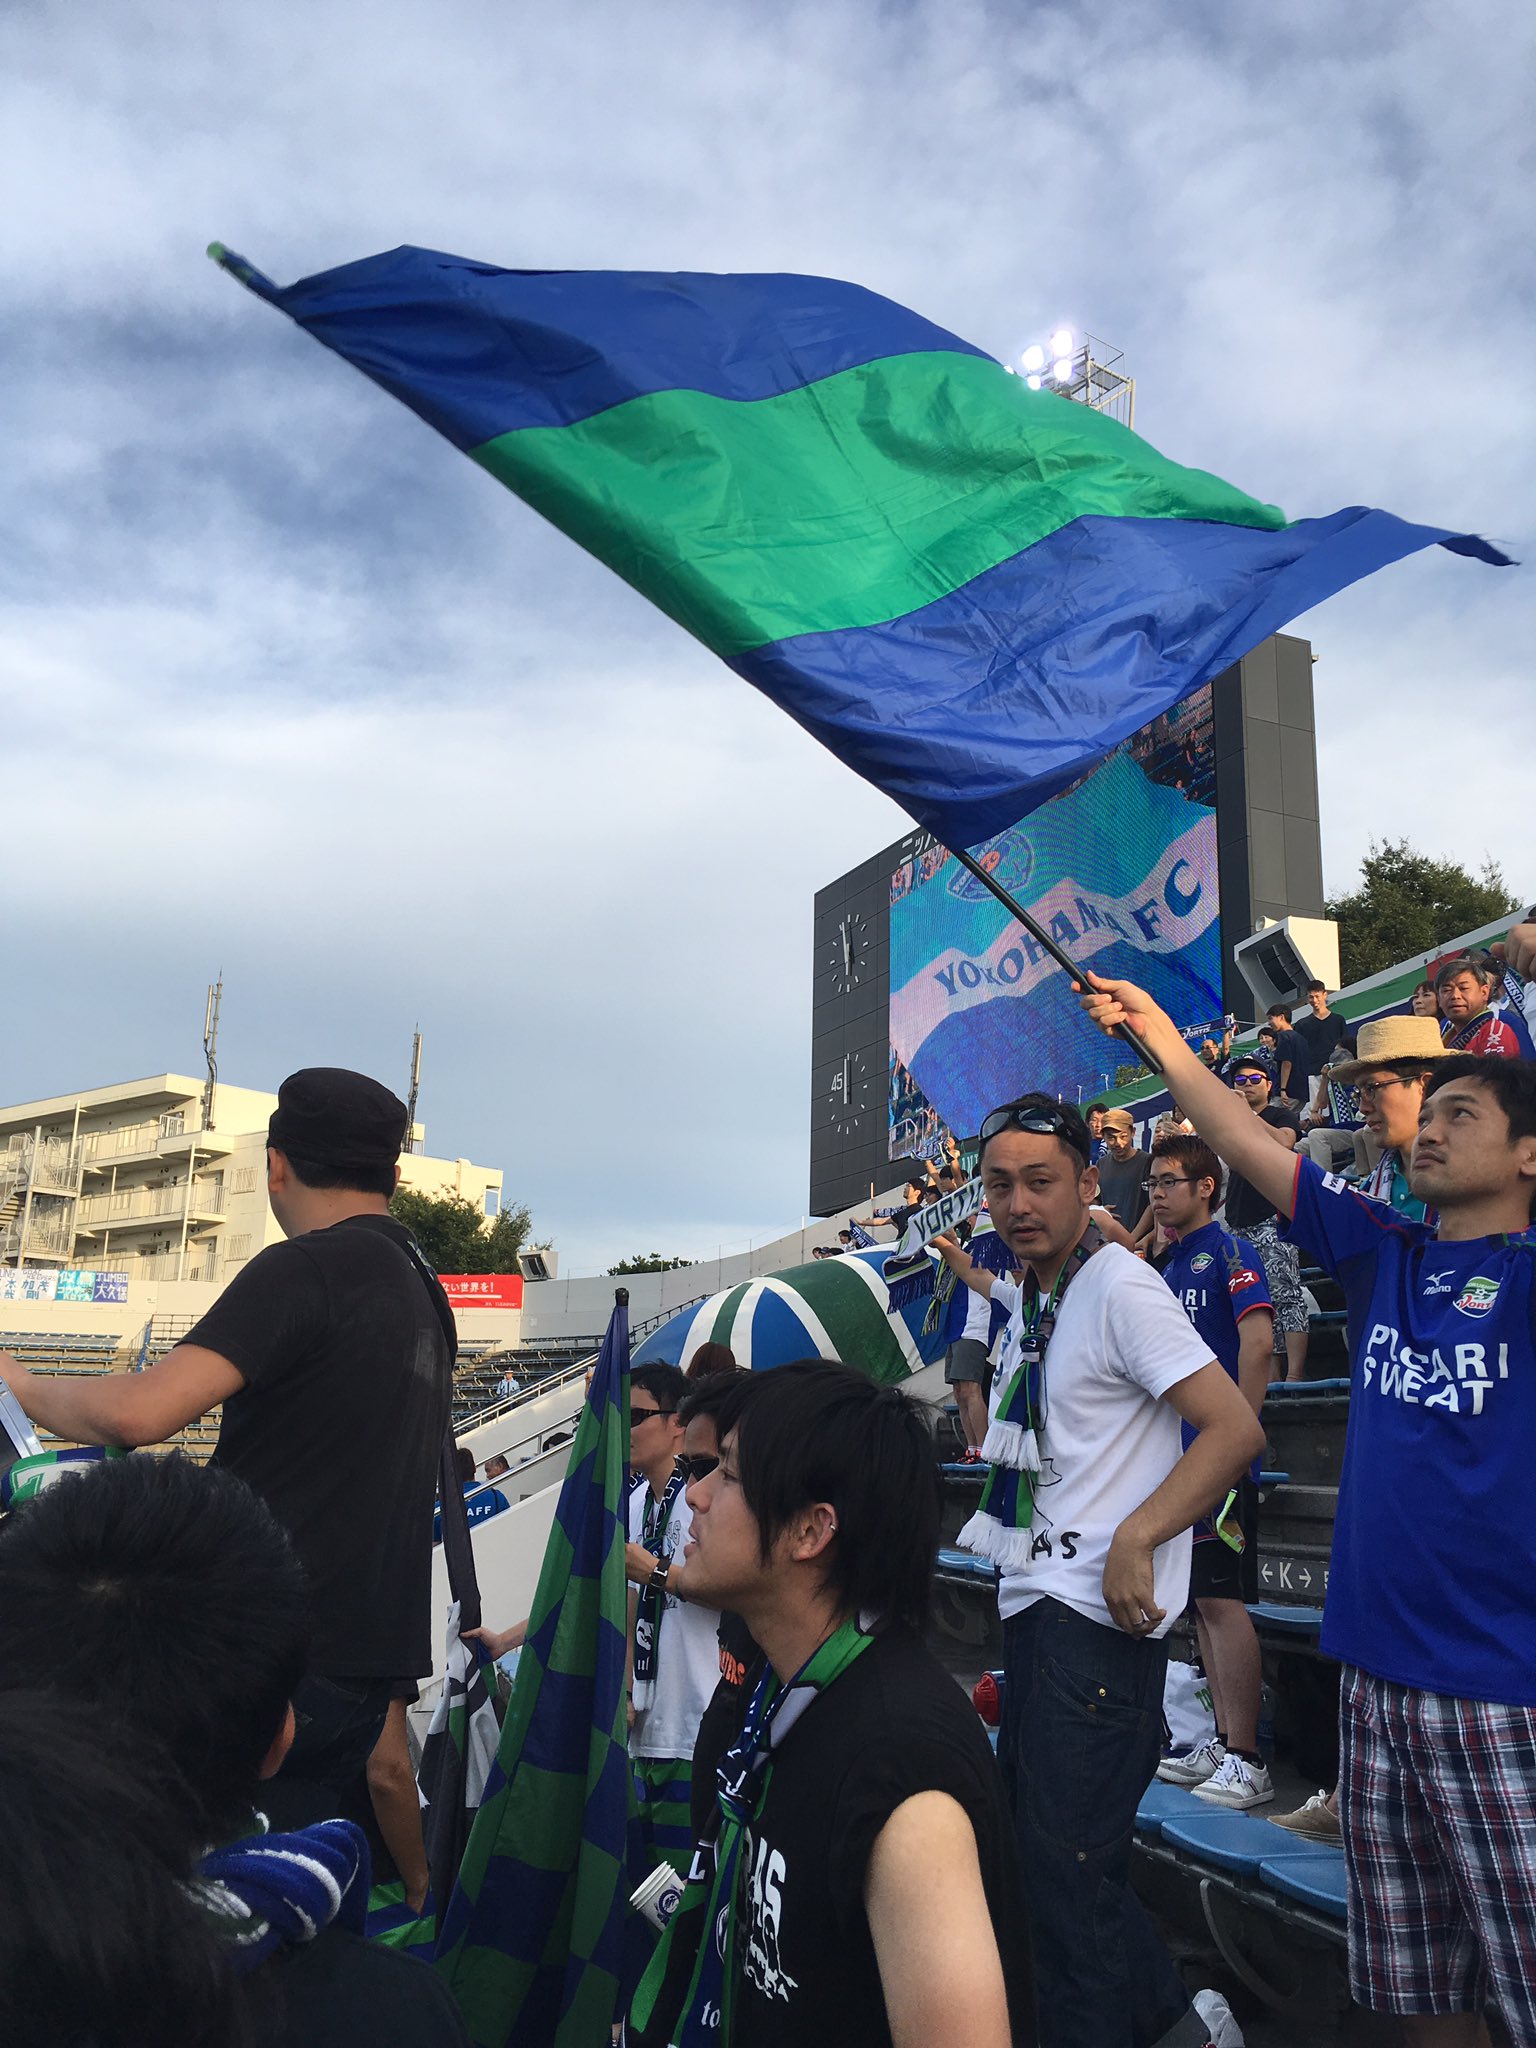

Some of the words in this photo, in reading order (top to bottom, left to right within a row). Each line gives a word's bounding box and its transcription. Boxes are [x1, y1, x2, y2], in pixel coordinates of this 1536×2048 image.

[900, 833, 938, 866] ニッ
[934, 897, 1130, 997] YOKOHAMA
[1131, 857, 1202, 943] FC
[831, 1071, 843, 1092] 45
[1228, 1272, 1255, 1292] アース
[467, 1505, 492, 1517] AFF
[1031, 1529, 1082, 1561] AS
[1280, 1561, 1294, 1590] K
